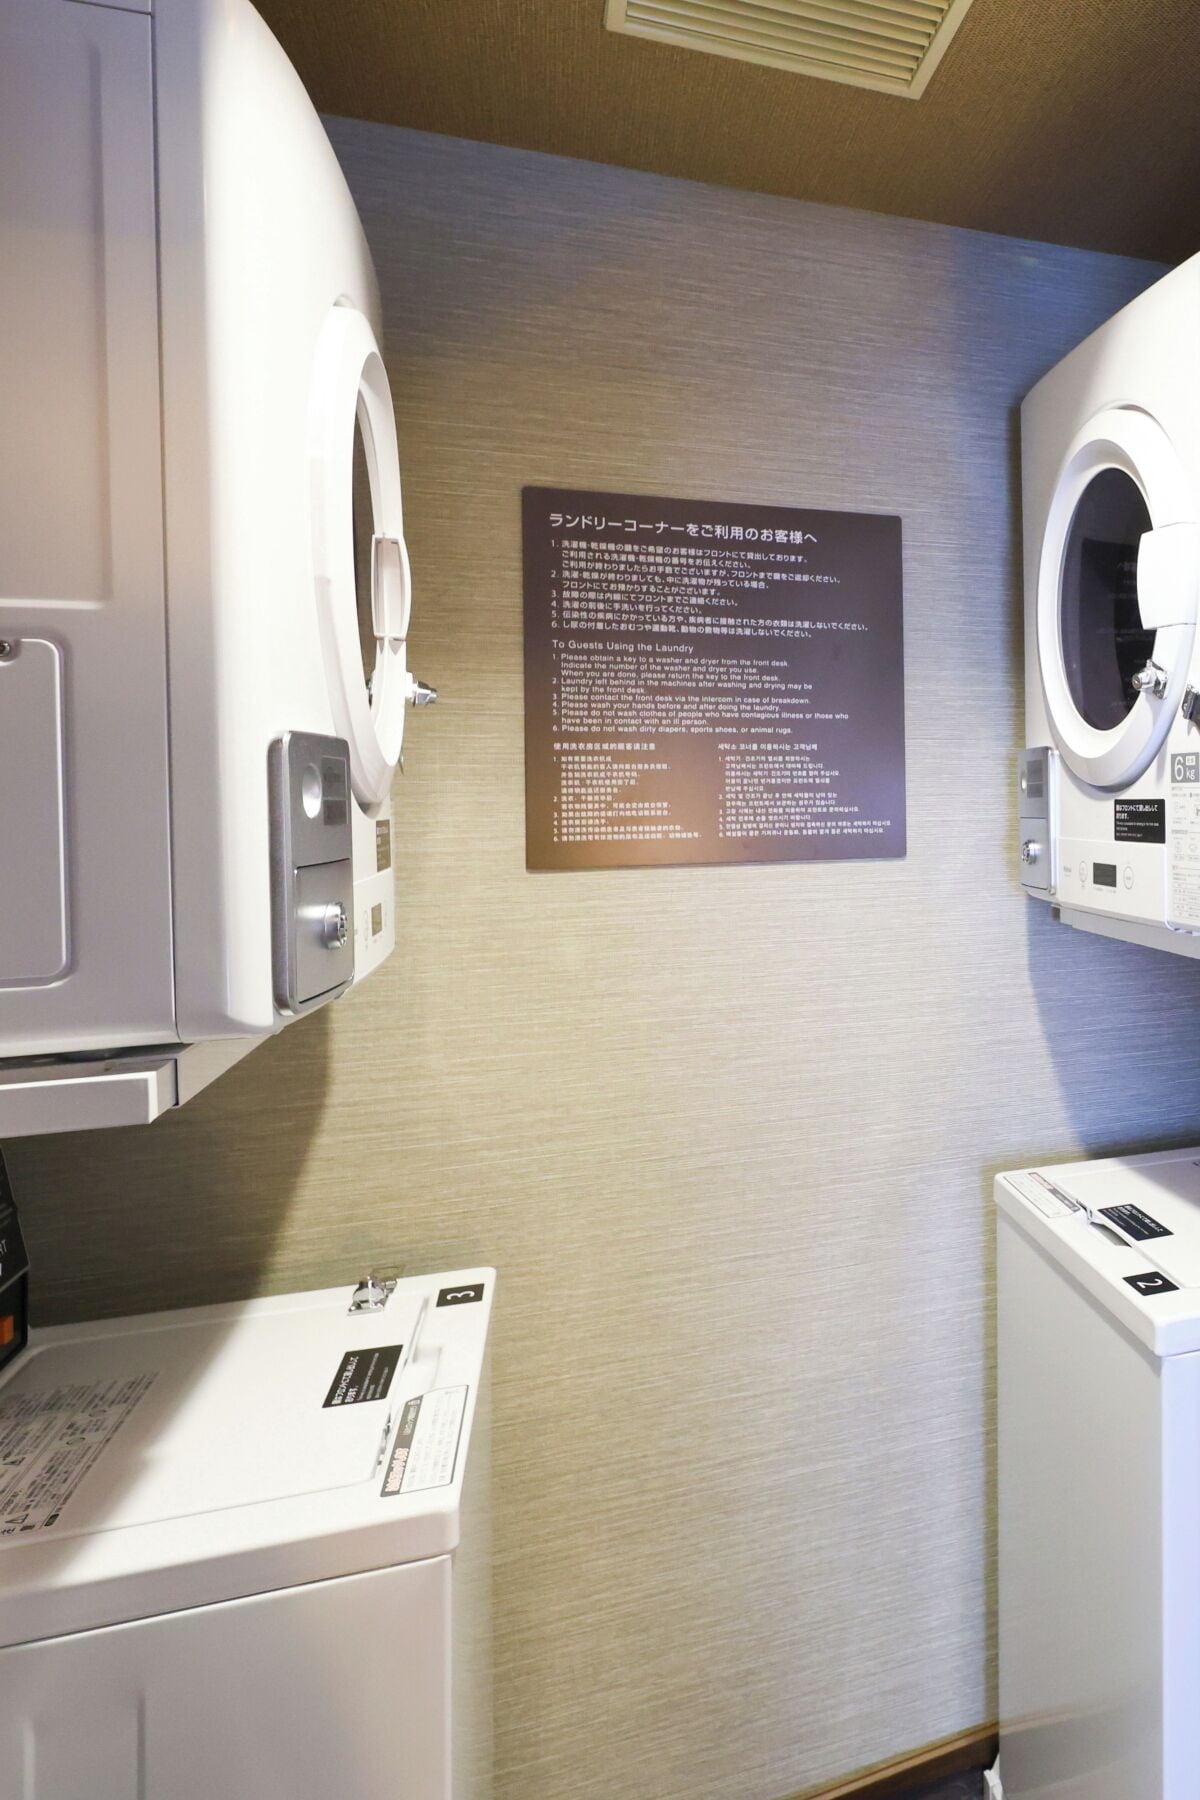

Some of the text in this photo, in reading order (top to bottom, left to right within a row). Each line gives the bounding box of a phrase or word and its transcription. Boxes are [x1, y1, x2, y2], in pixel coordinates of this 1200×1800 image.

[549, 513, 818, 544] ランドリーコーナーをご利用のお客様へ
[552, 640, 693, 654] To Guests Using the Laundry
[1174, 757, 1184, 780] 6
[1186, 767, 1196, 781] kg
[1136, 1278, 1163, 1289] 2
[446, 1290, 475, 1301] 3
